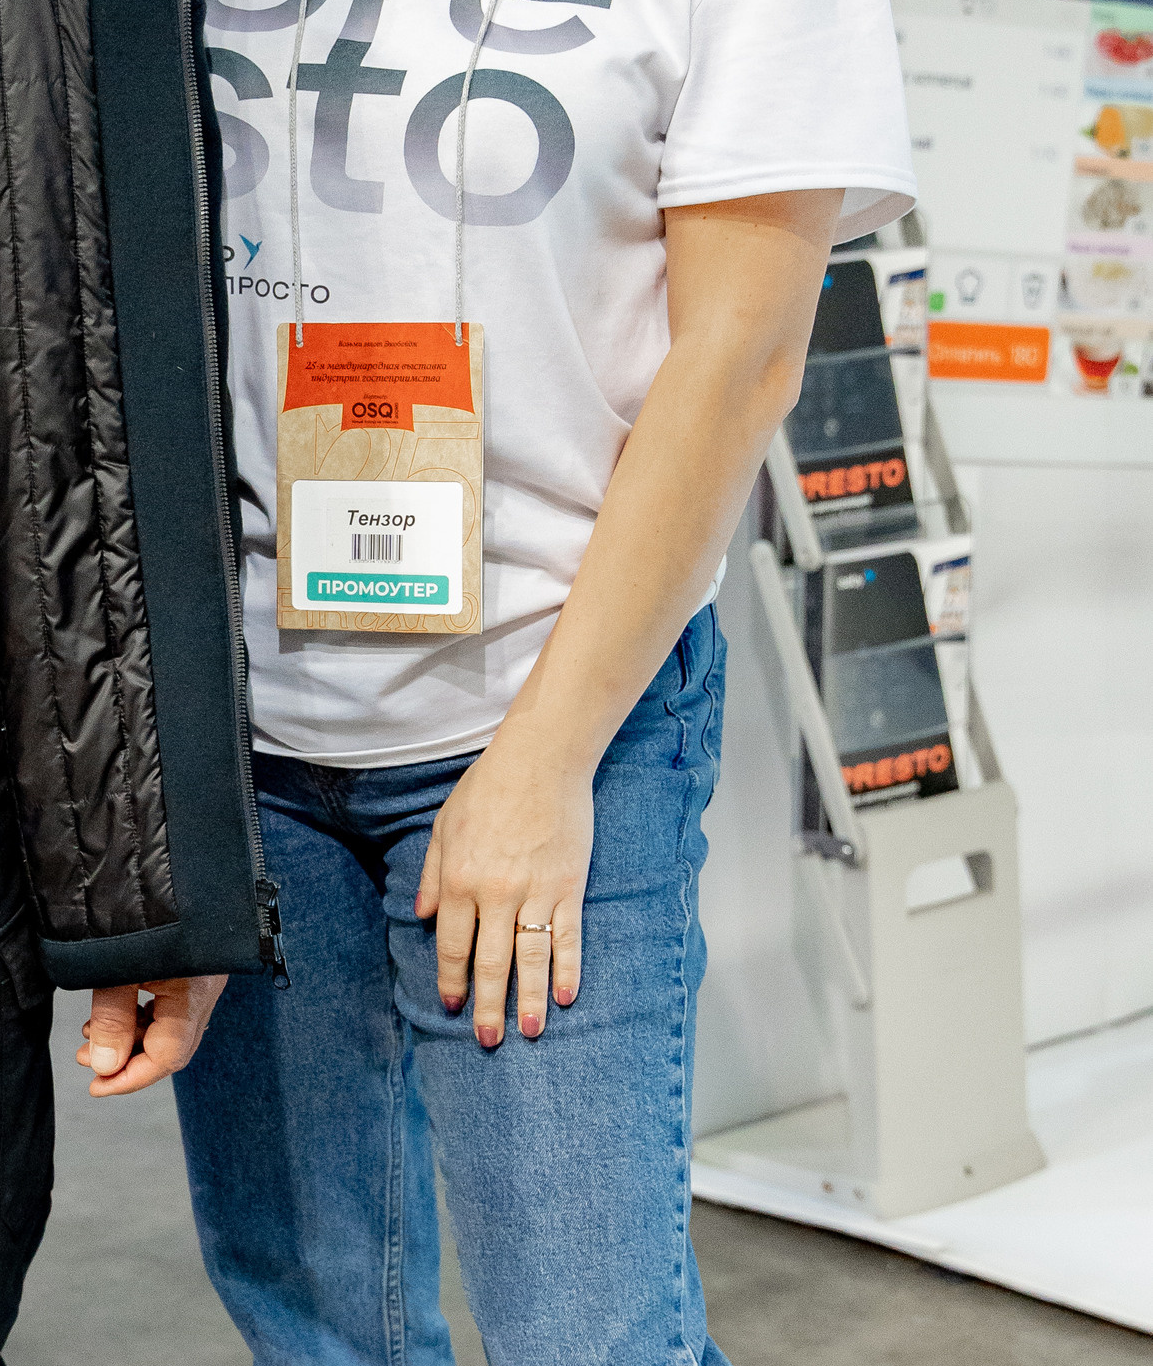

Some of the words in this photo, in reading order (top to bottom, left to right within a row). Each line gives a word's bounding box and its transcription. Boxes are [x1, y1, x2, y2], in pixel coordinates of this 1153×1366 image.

[351, 402, 393, 418] OSQ
[347, 509, 416, 531] Тензор
[317, 579, 439, 598] ПРОМОУТЕР
